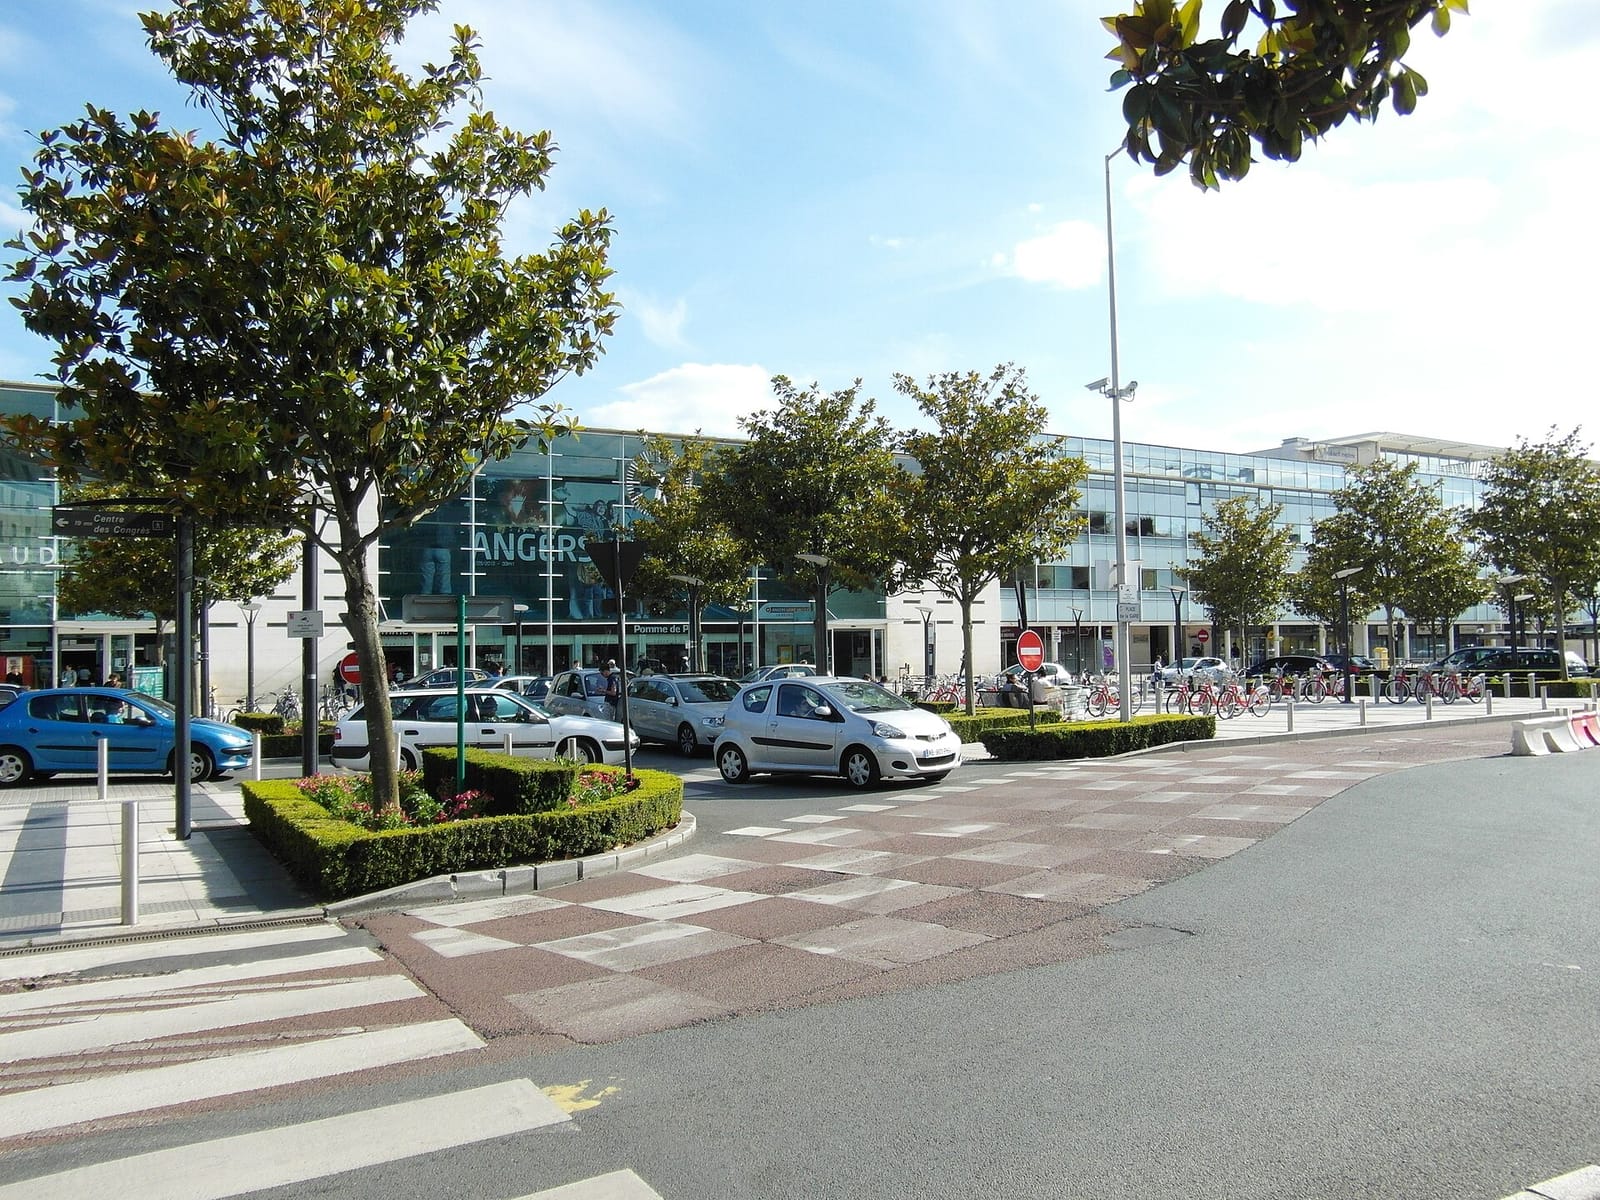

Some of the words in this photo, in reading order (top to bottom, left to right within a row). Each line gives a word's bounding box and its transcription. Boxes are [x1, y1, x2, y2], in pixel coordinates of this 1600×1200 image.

[93, 514, 125, 524] Centre
[93, 526, 110, 534] des
[113, 525, 151, 536] Congrès
[474, 532, 592, 562] ANGERS
[0, 546, 55, 565] UD
[633, 625, 668, 633] Pomme
[670, 625, 681, 633] de
[683, 625, 689, 633] P
